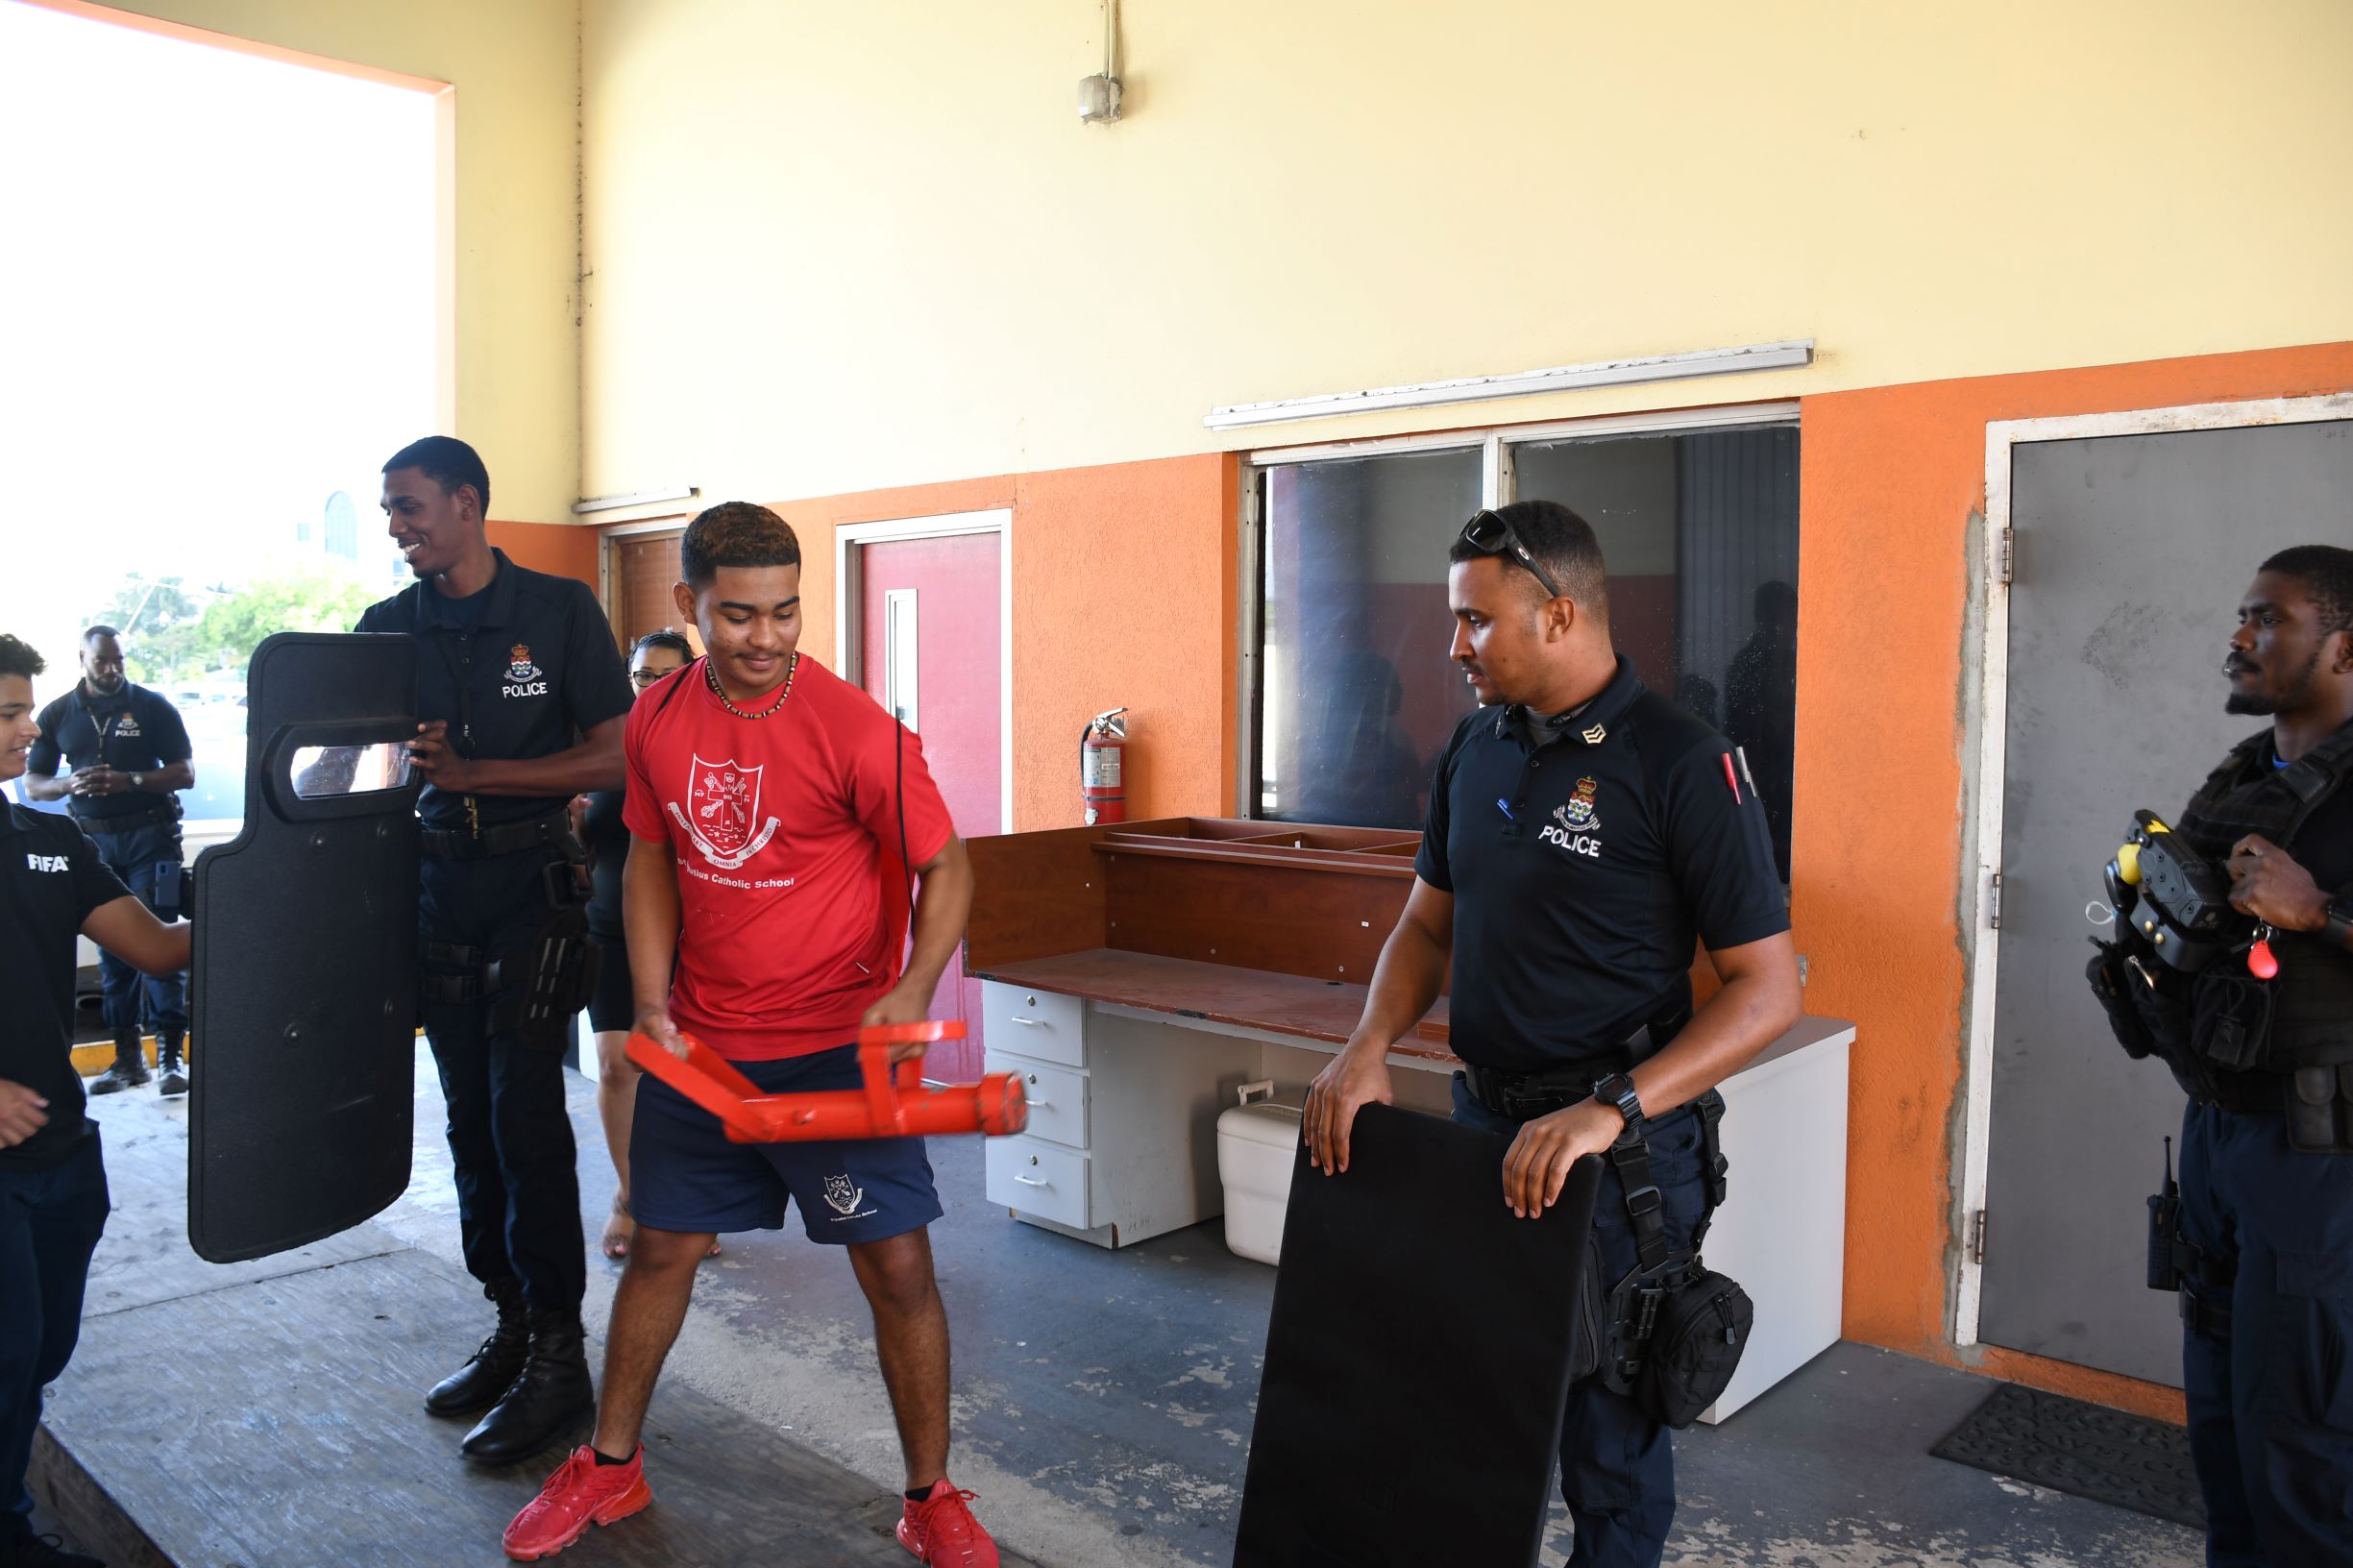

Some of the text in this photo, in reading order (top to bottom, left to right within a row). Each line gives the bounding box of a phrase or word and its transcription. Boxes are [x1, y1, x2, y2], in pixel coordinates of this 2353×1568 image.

[502, 682, 548, 698] POLICE
[114, 729, 141, 738] POLICE
[1537, 824, 1603, 858] POLICE
[27, 853, 69, 872] FIFA
[713, 858, 737, 868] OMNIA
[711, 873, 751, 890] Catholic
